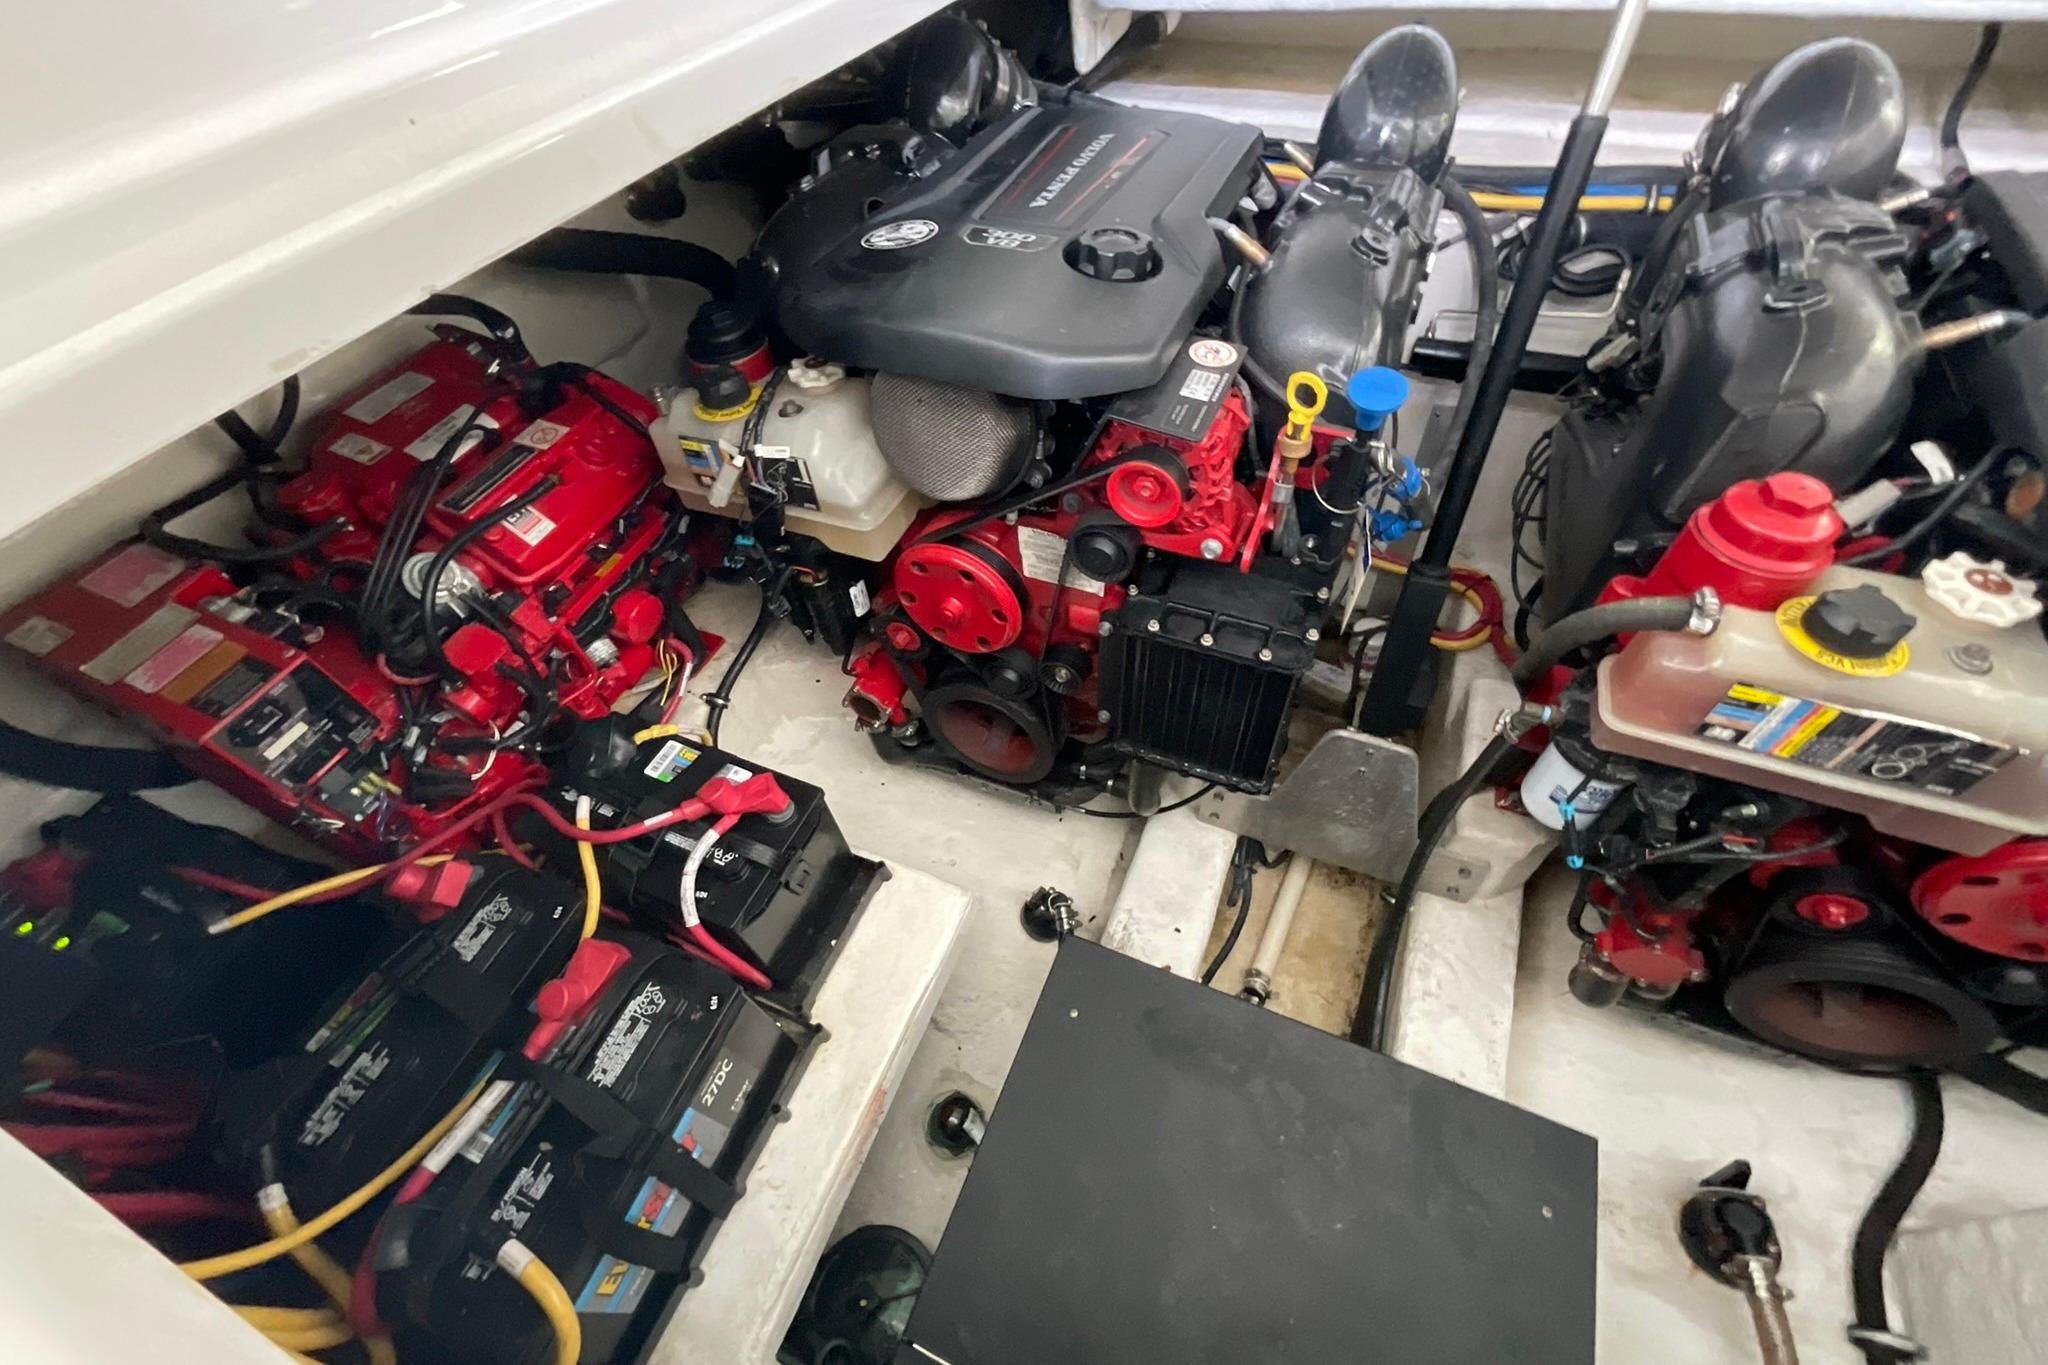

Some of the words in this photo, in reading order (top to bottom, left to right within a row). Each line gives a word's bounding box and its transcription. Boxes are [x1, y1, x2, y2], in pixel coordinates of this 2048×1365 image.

[1072, 133, 1116, 166] VOLVO
[1029, 165, 1081, 208] PENTA
[701, 1058, 734, 1108] 27DC
